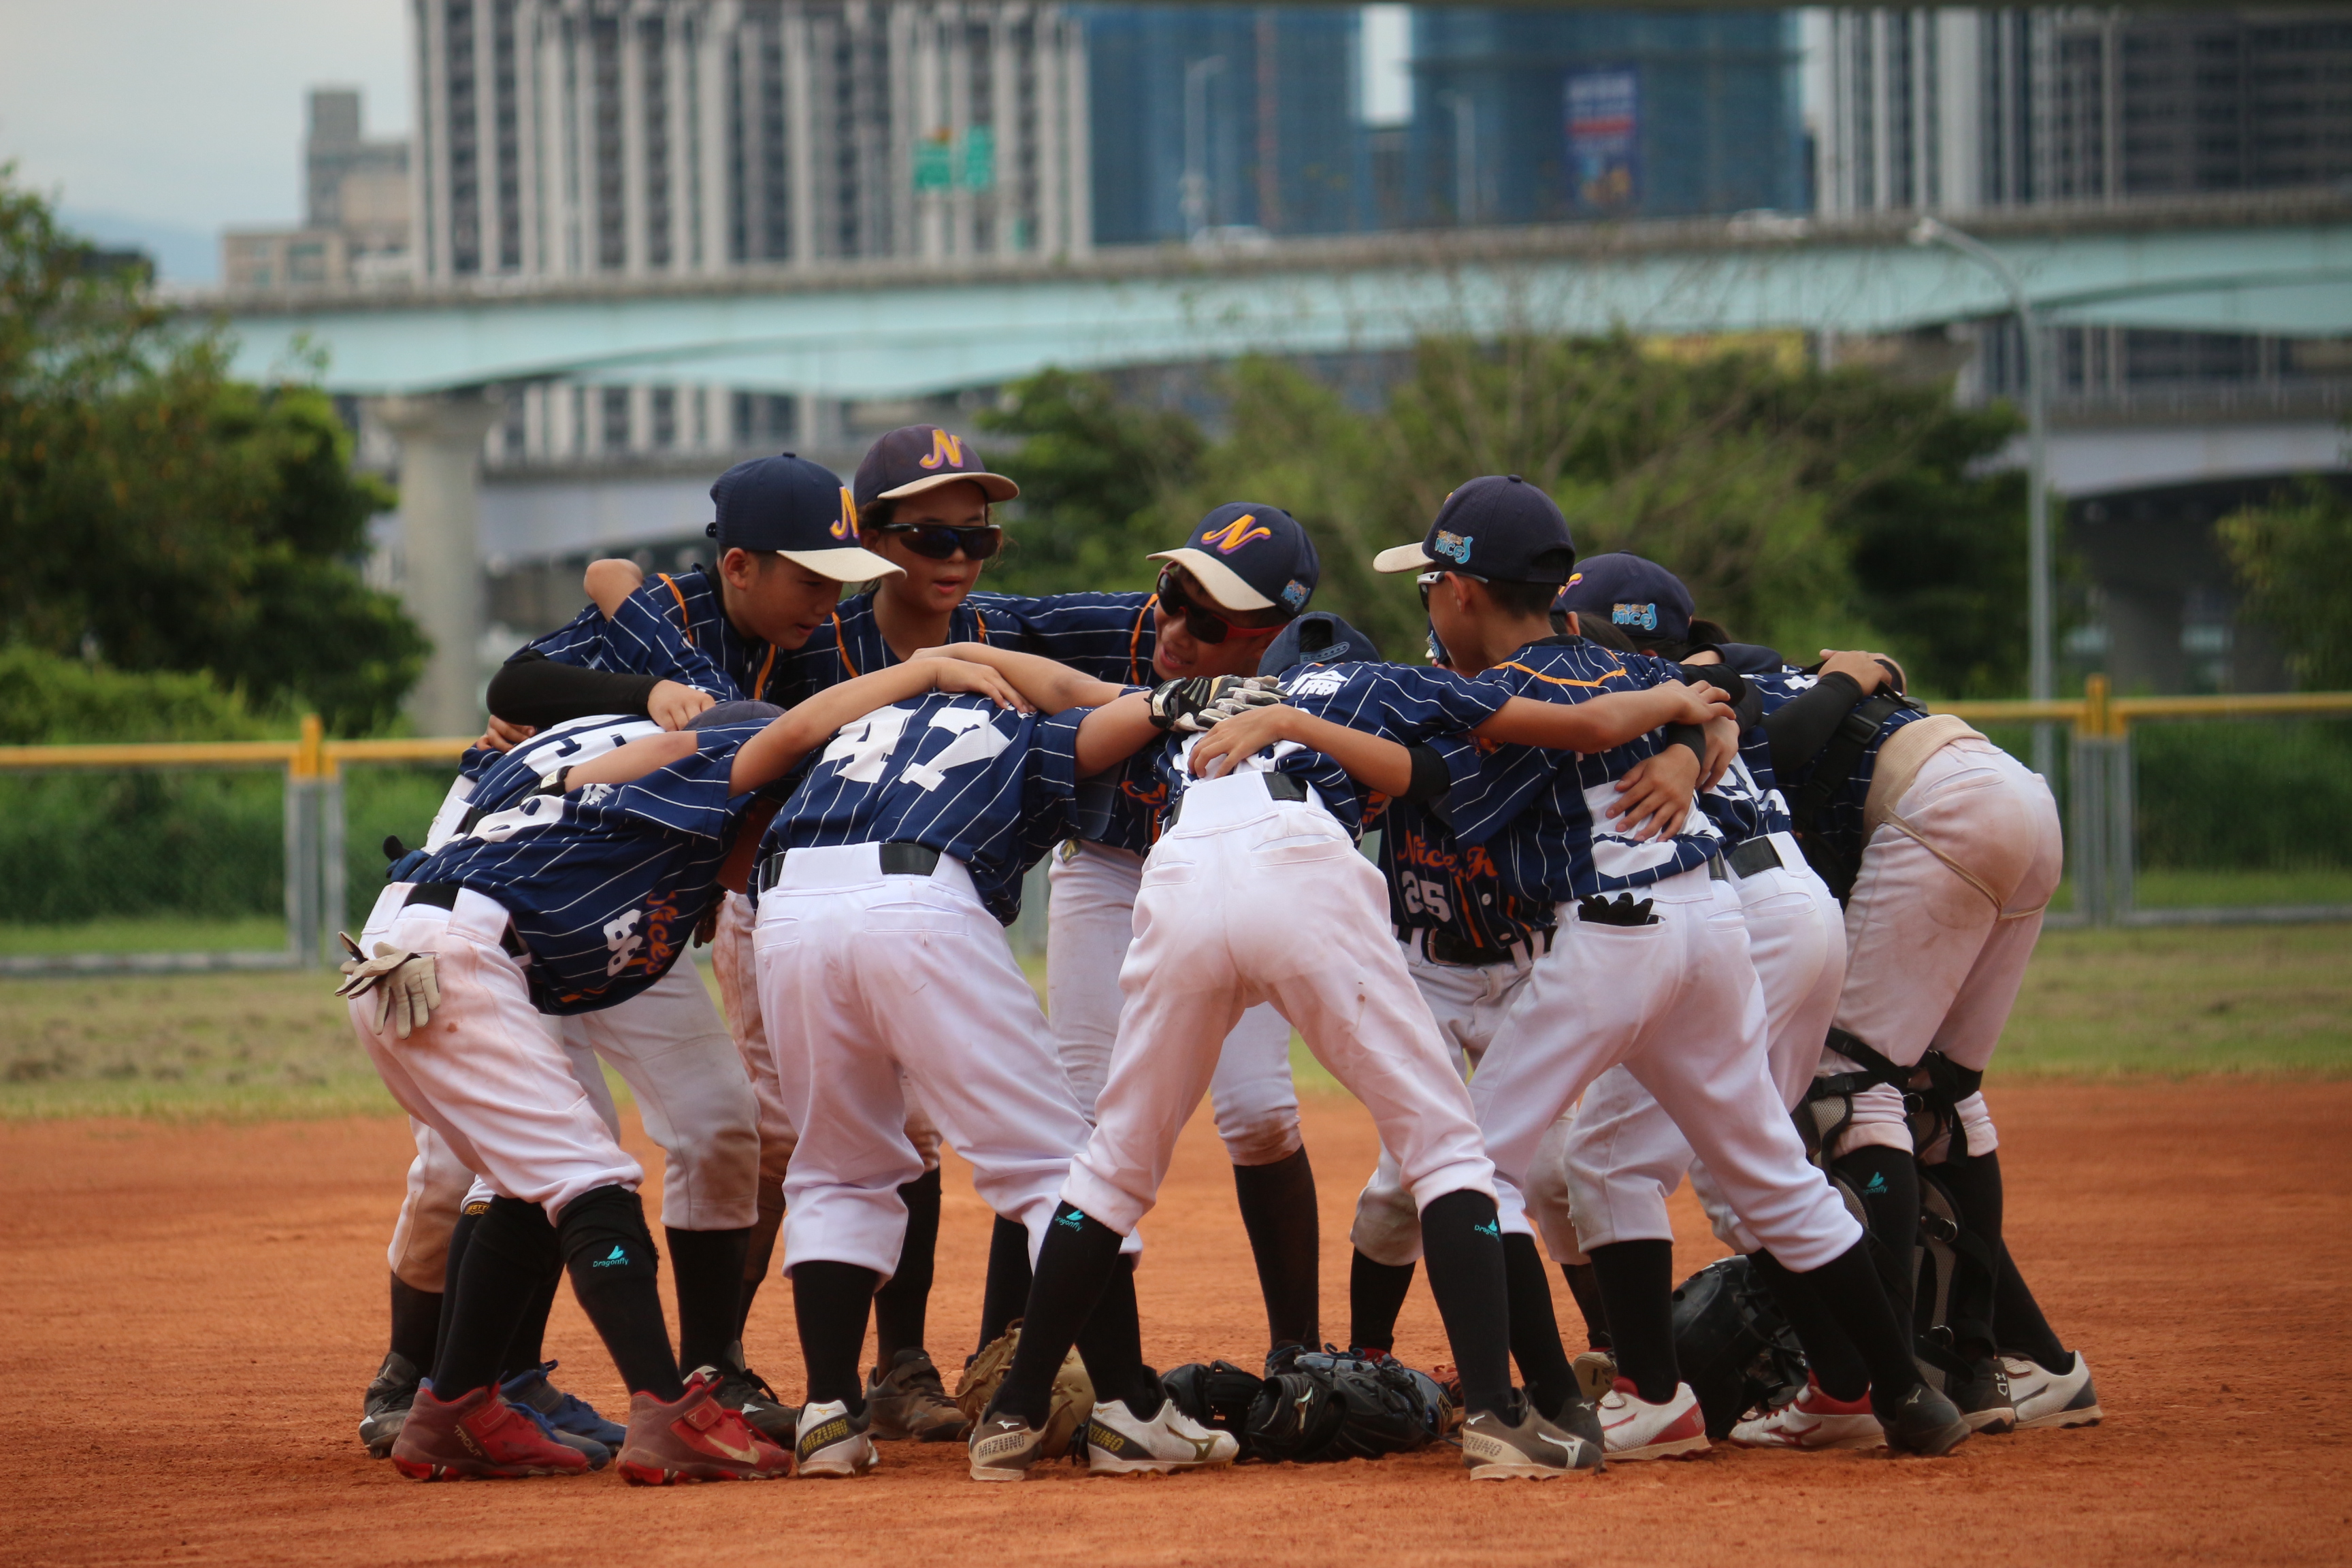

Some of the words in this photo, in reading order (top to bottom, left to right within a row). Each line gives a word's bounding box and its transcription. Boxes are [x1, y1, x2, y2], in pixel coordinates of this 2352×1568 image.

[919, 429, 964, 469] N
[1200, 514, 1272, 555] N
[821, 705, 1011, 792] 47
[1402, 870, 1452, 922] 25
[603, 909, 643, 977] 88
[593, 1257, 629, 1267] Dragonfly
[454, 1424, 482, 1456] TROUT
[801, 1418, 848, 1456] MIZUNO
[978, 1433, 1025, 1460] MIZUNO
